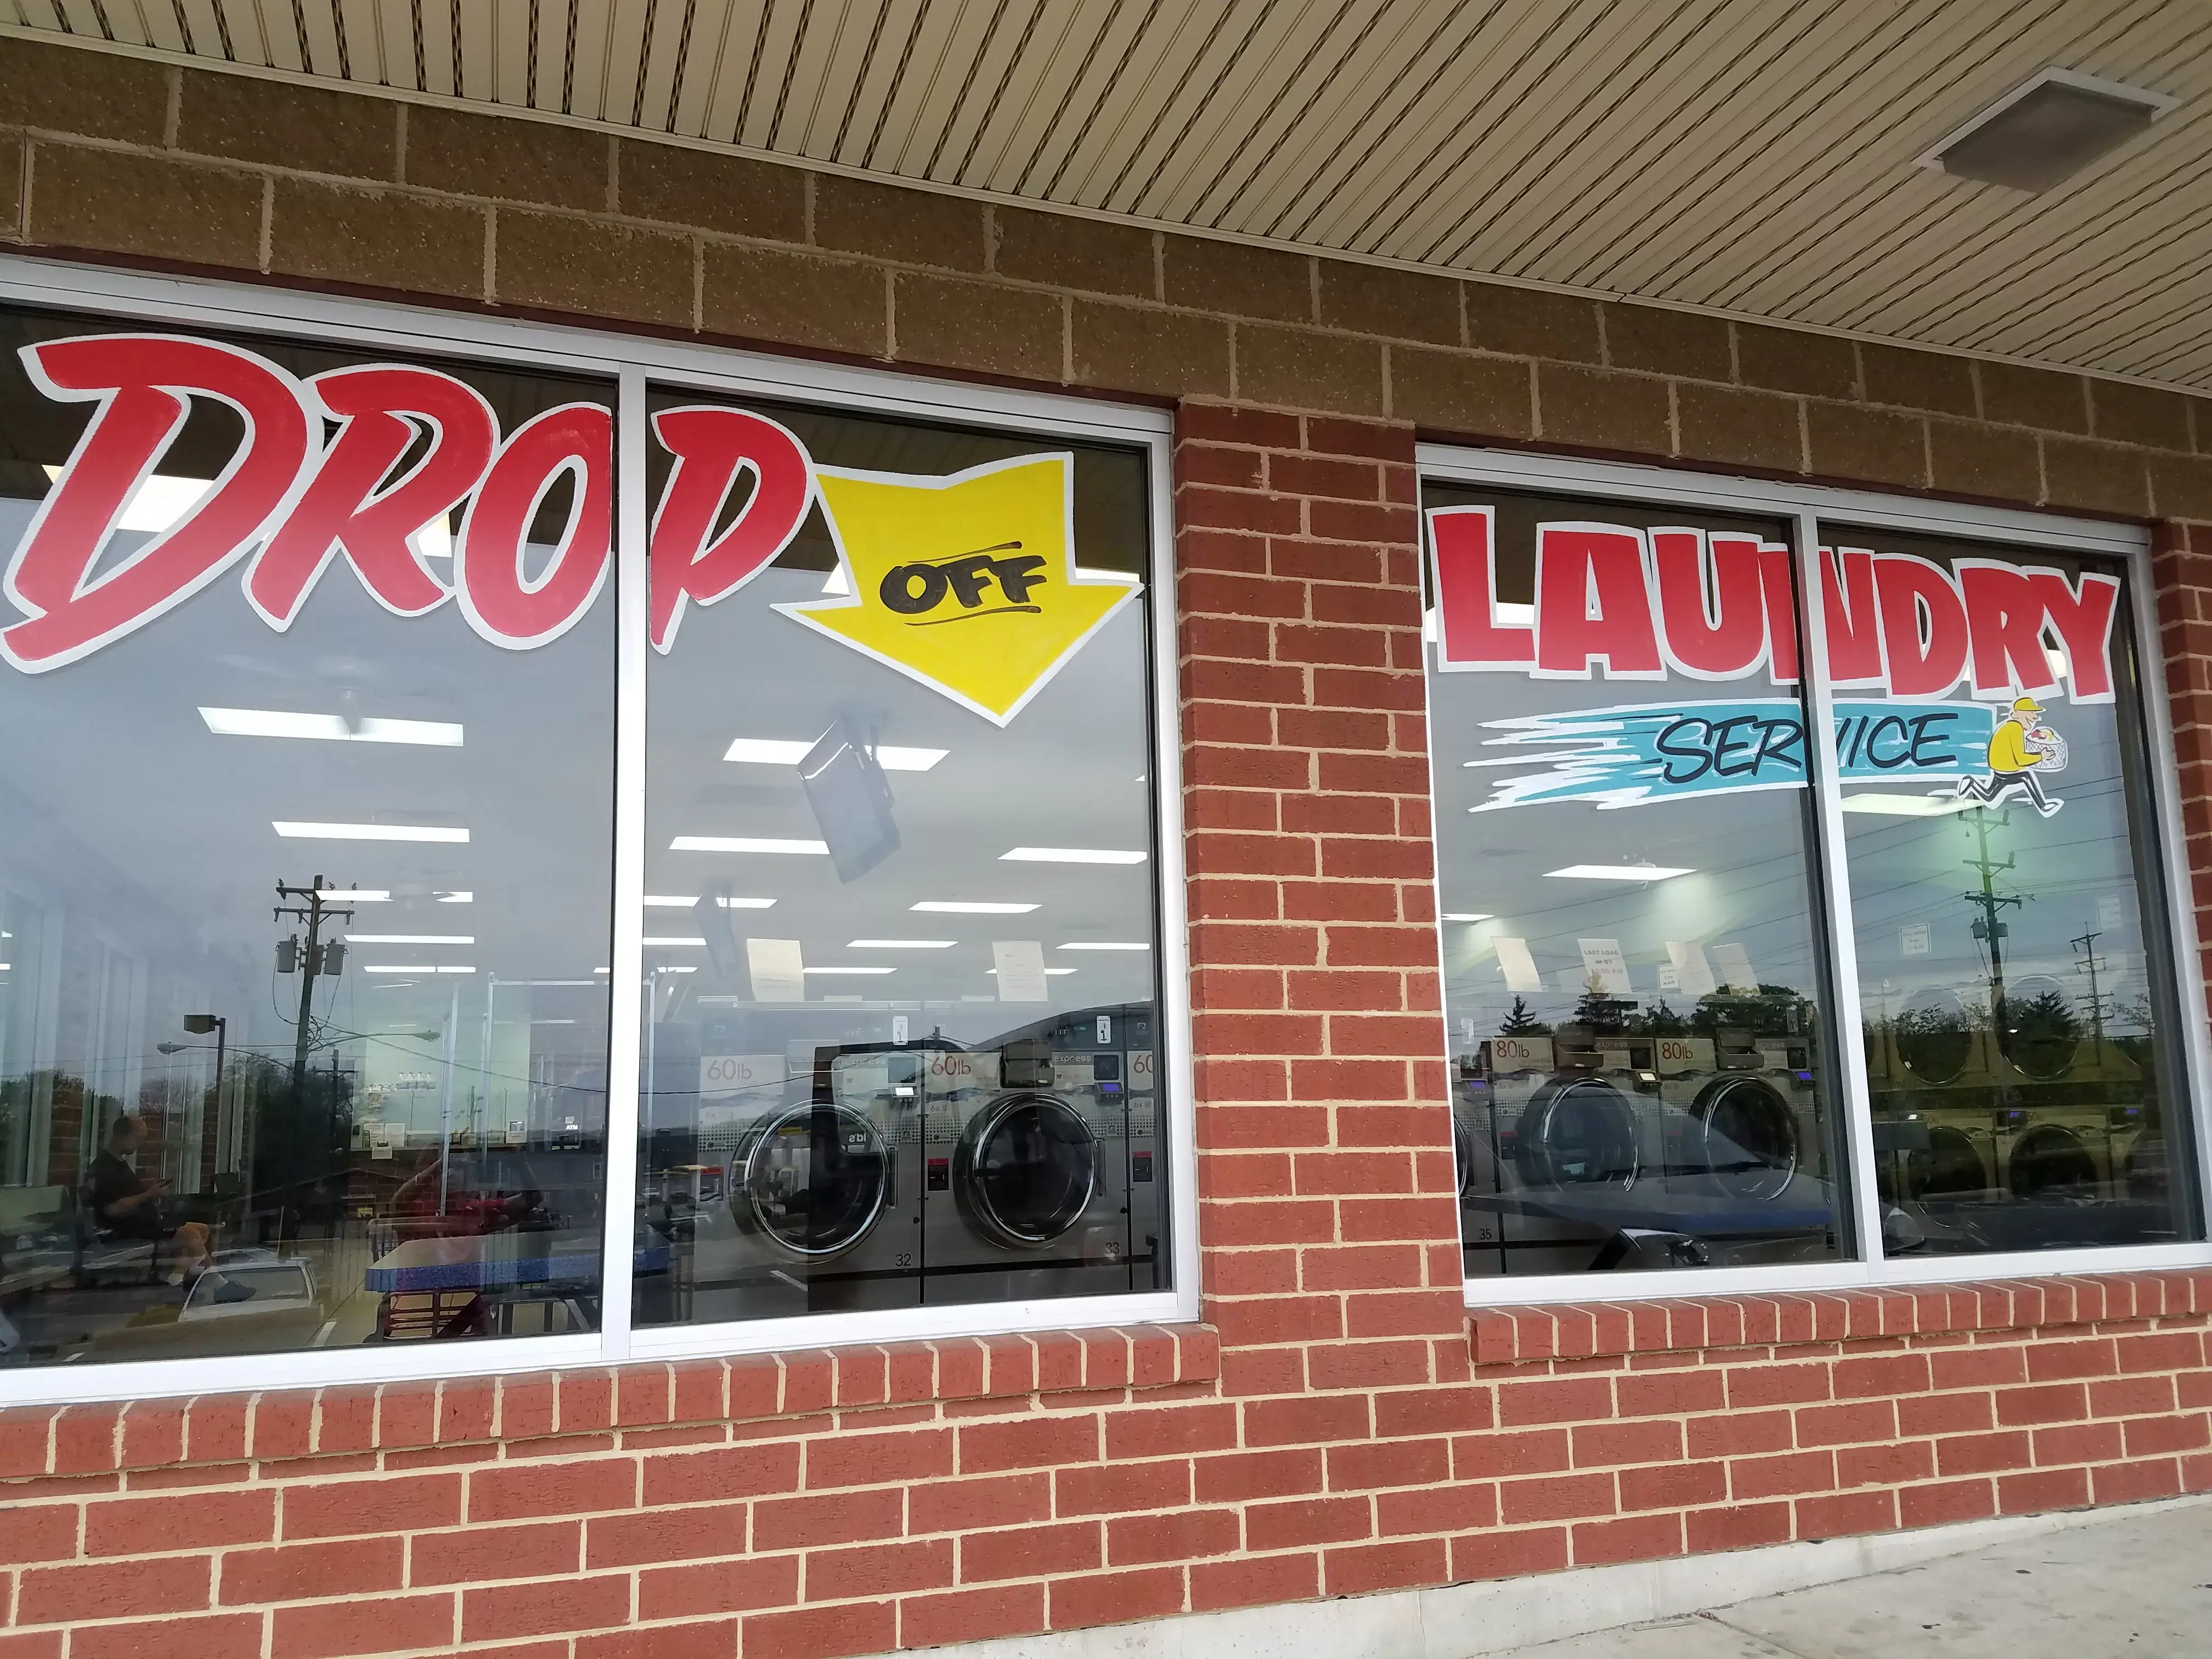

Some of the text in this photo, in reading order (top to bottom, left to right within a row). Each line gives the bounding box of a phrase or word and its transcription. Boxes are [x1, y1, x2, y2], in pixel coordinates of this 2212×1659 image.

[1, 335, 1047, 670] DROP OFF
[1427, 507, 2118, 704] LAUNDRY
[1497, 1040, 1530, 1058] 80lb
[1596, 1041, 1628, 1049] express
[1662, 1042, 1693, 1060] 80lb
[931, 1055, 971, 1076] 60lb
[1054, 1055, 1092, 1064] express
[707, 1058, 752, 1080] 60lb
[1479, 1228, 1492, 1240] 35
[1105, 1242, 1120, 1255] 33
[895, 1253, 911, 1267] 32
